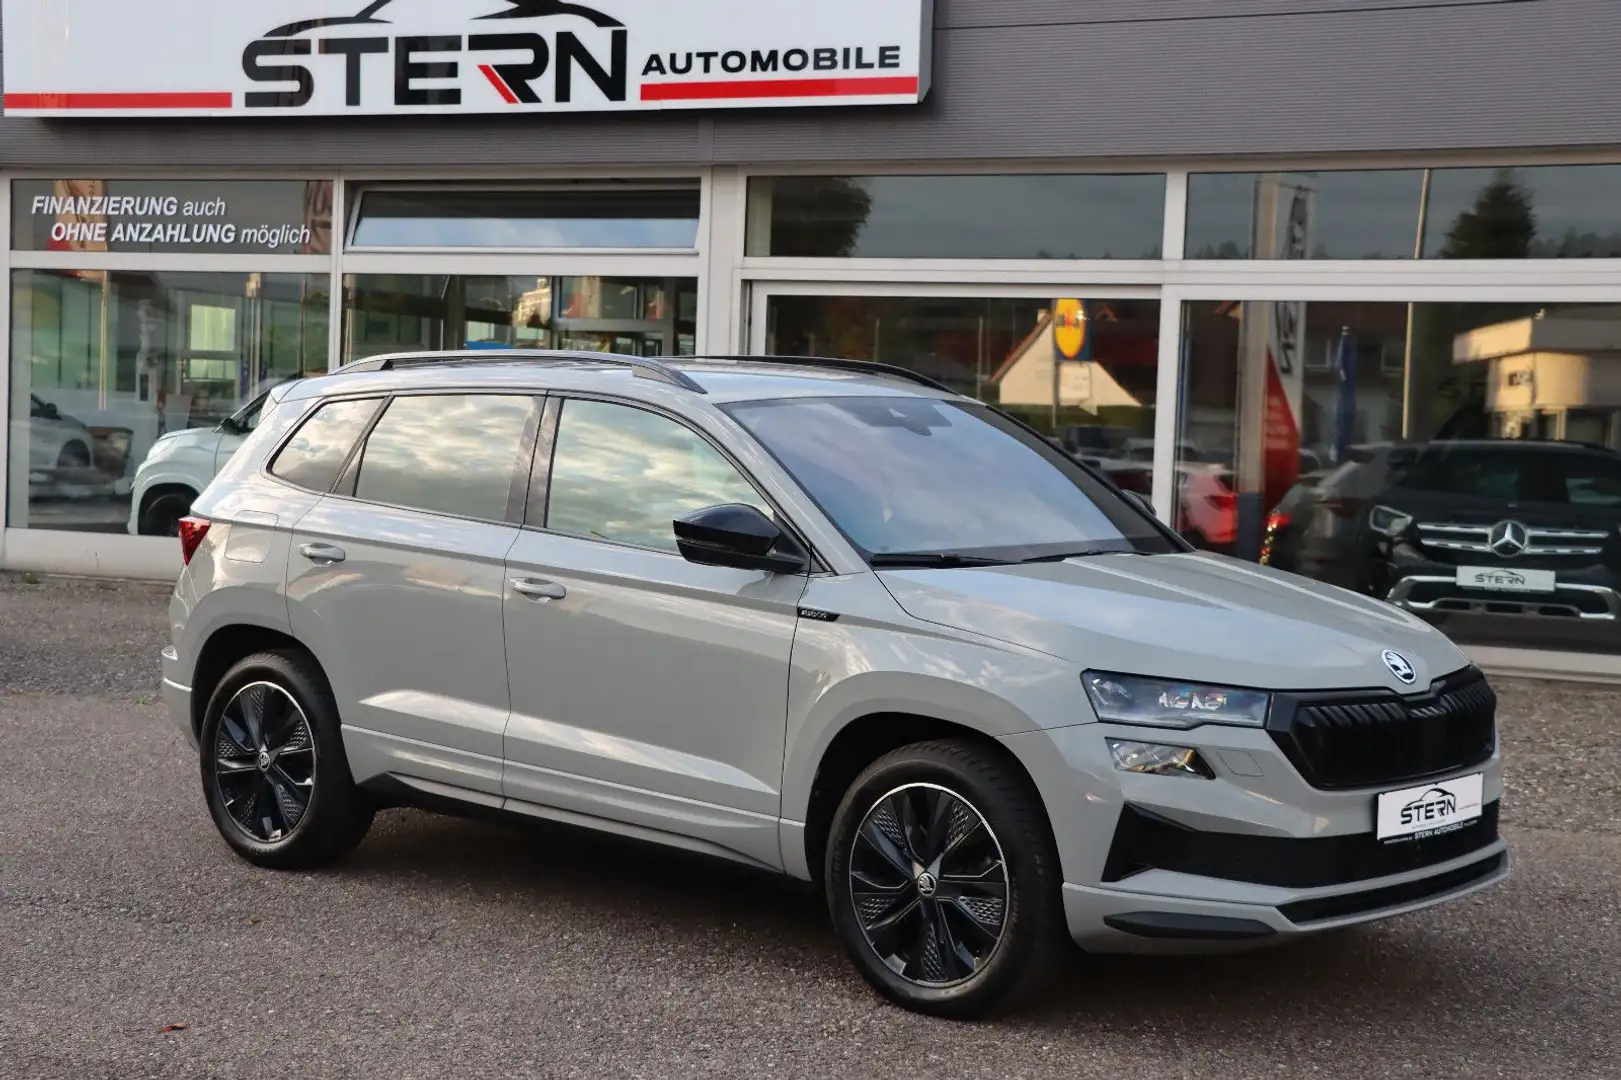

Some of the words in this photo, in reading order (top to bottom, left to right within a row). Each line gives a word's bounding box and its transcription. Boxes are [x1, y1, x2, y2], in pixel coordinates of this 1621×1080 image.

[242, 28, 628, 107] STERN
[642, 45, 901, 77] AUTOMOBILE
[31, 195, 178, 216] FINANZIERUNG
[183, 196, 226, 216] auch
[51, 222, 108, 243] OHNE
[111, 223, 236, 244] ANZAHLUNG
[240, 224, 311, 248] möglich
[1474, 573, 1526, 585] STERN
[1400, 797, 1457, 825] STERN
